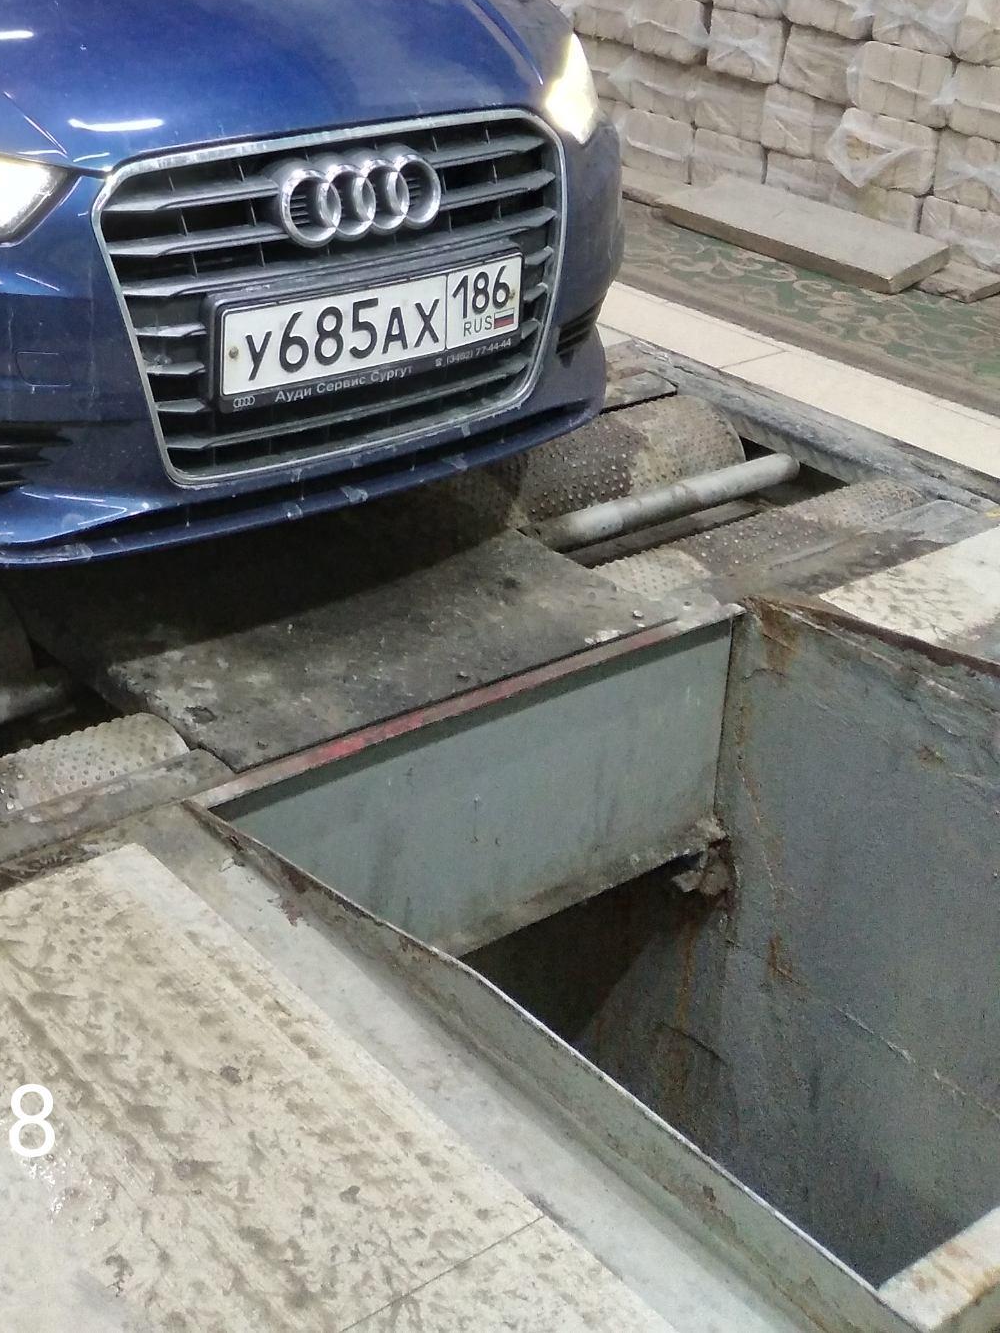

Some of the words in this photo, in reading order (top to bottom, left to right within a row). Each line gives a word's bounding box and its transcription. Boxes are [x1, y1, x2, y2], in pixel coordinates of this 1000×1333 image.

[452, 266, 511, 319] 186
[463, 315, 493, 338] RUS
[274, 389, 312, 404] Ауди
[316, 374, 366, 396] Сервис
[370, 365, 413, 384] Сургут
